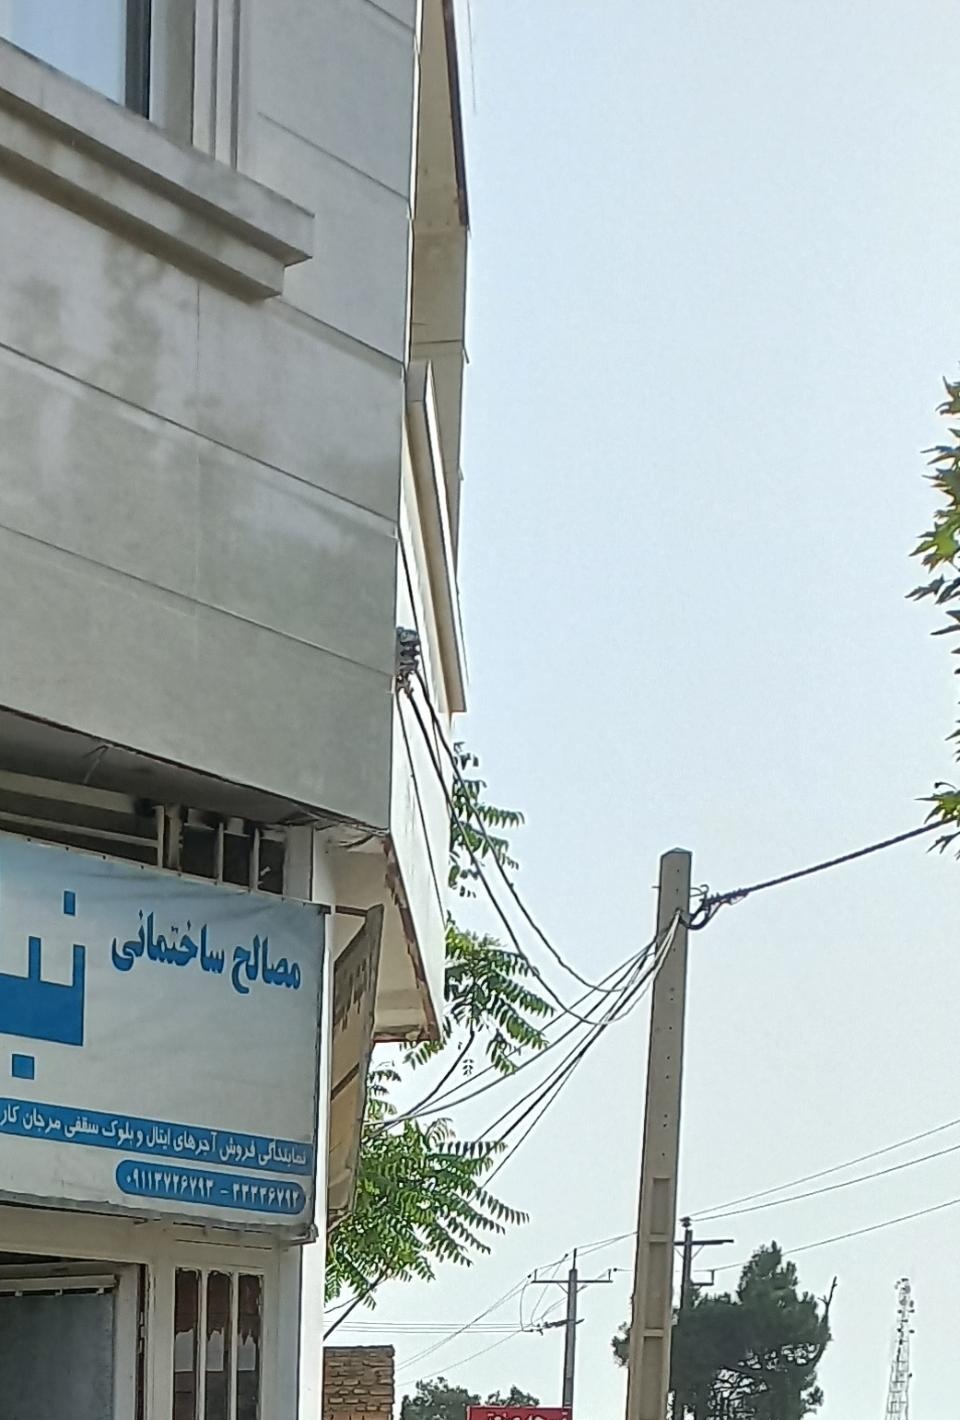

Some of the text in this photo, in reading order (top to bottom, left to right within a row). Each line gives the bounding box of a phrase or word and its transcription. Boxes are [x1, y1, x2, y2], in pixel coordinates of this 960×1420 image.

[111, 909, 301, 994] مصالح ساختمانی
[0, 1103, 307, 1168] نمایندگی فروش آجرهای ایتال و بلوک سقفی مرجان کار
